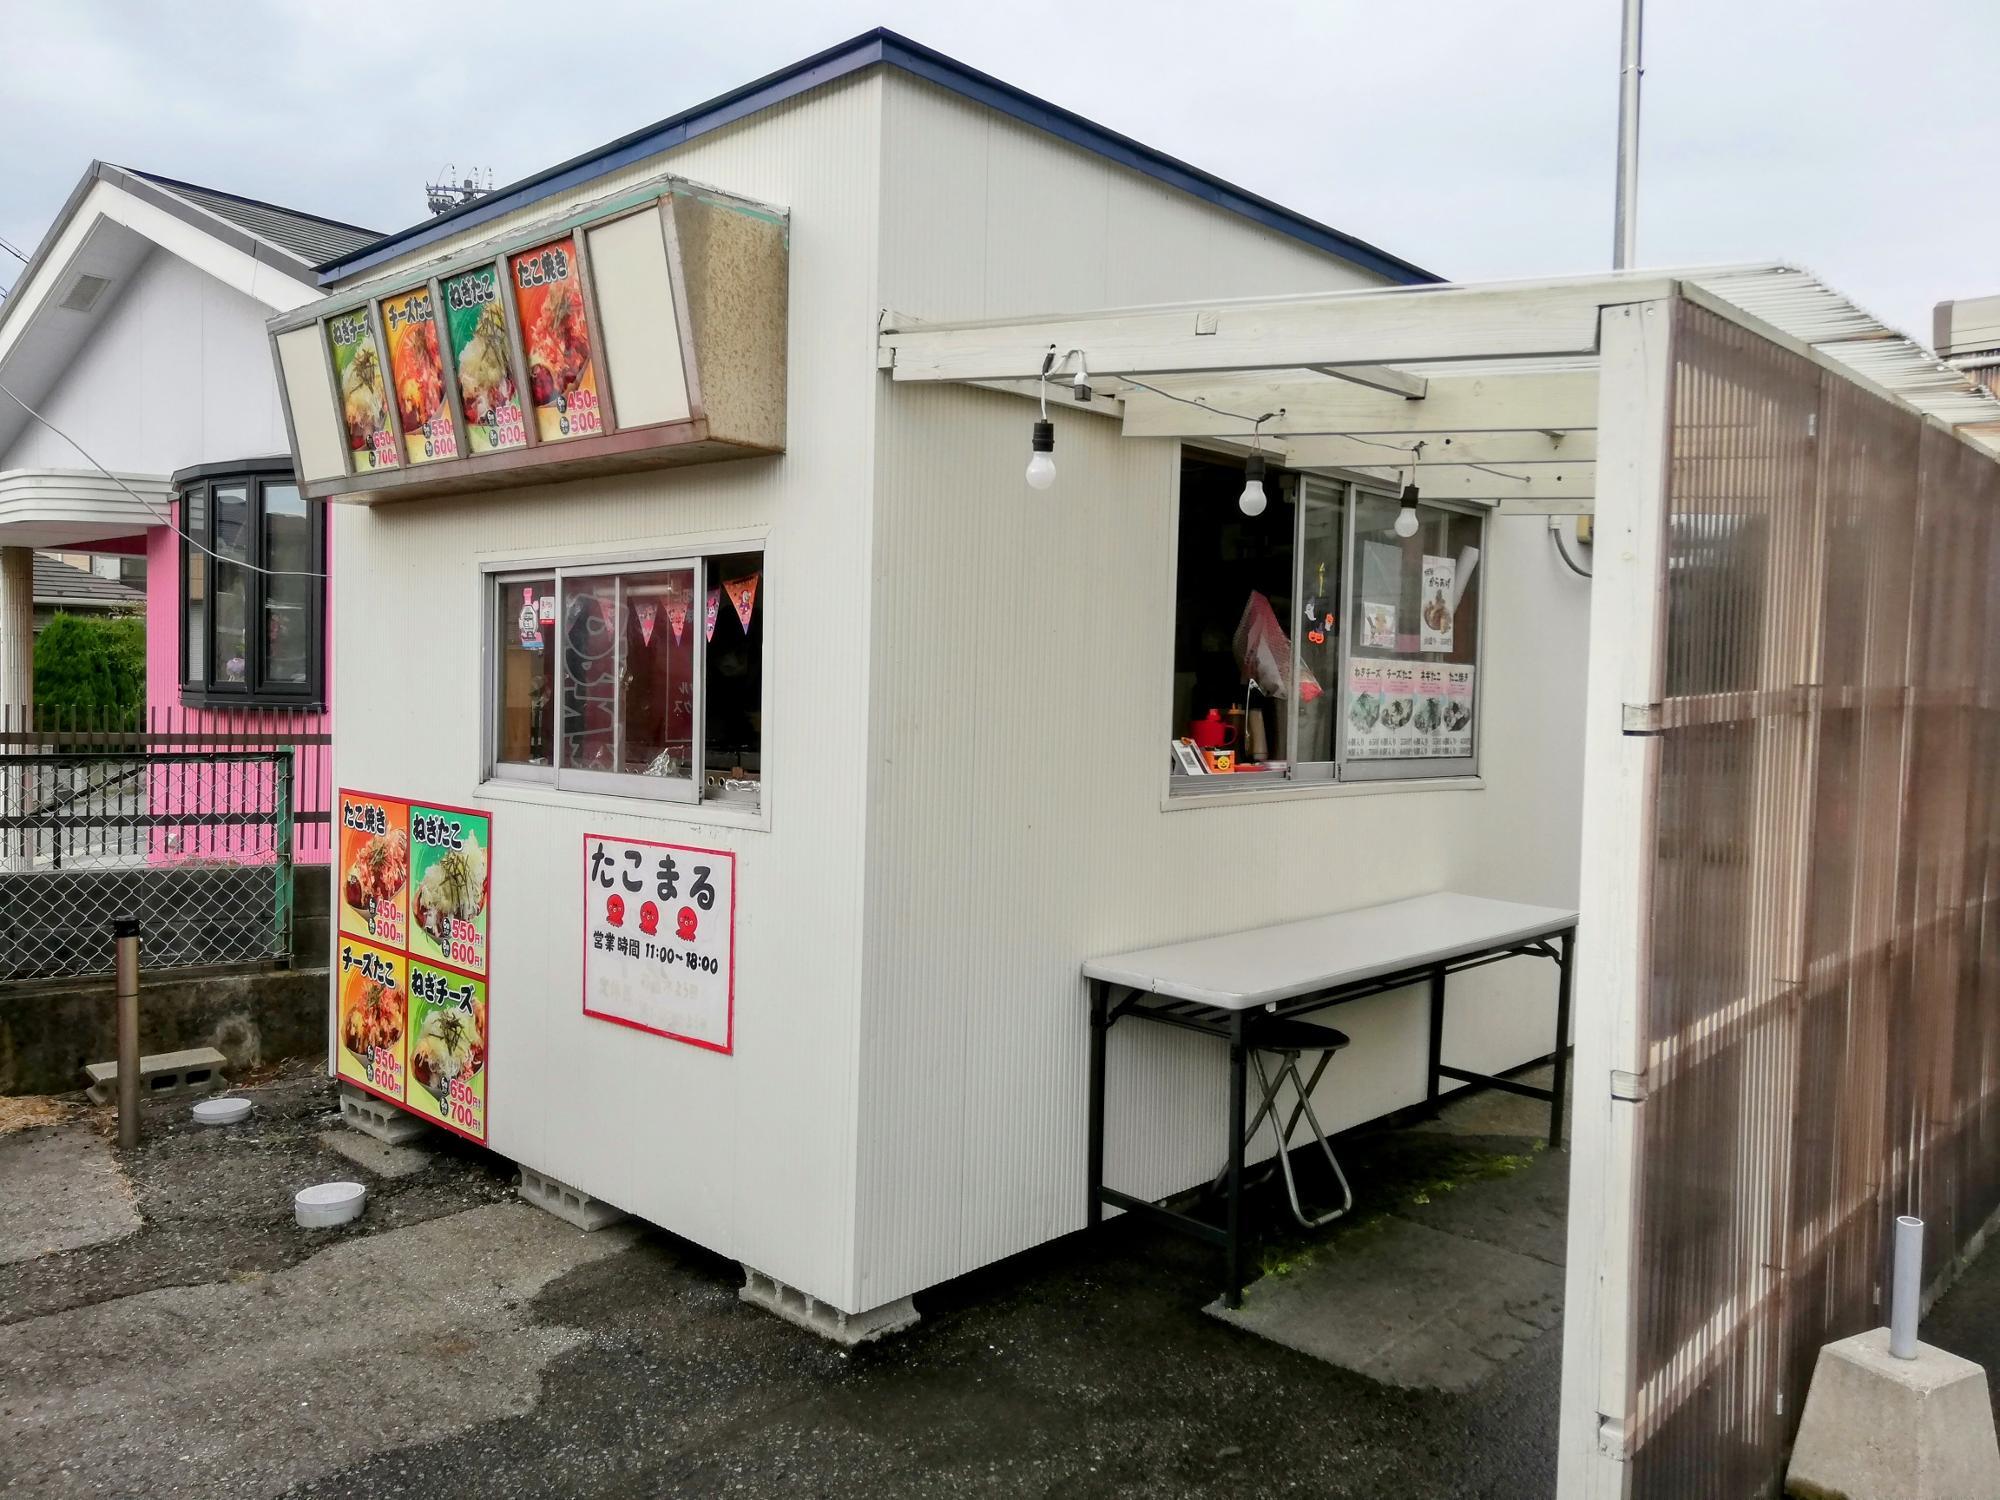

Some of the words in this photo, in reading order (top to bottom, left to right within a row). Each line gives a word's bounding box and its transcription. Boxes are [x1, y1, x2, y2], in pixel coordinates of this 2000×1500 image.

[516, 247, 567, 288] たこ焼き
[448, 274, 494, 310] ねぎたこ
[344, 800, 386, 836] たこ焼き
[412, 813, 463, 849] ねぎたこ
[591, 842, 716, 911] たこまる
[376, 900, 402, 921] 450円
[376, 920, 402, 943] 500円
[452, 919, 480, 943] 550円
[593, 931, 640, 960] 営業時間
[342, 945, 395, 987] チーズたこ
[452, 942, 480, 966] 600円
[411, 968, 475, 1015] ねぎチーズ
[375, 1047, 400, 1073] 550円
[375, 1067, 400, 1093] 600円
[450, 1079, 479, 1108] 650円
[450, 1101, 479, 1129] 700円
